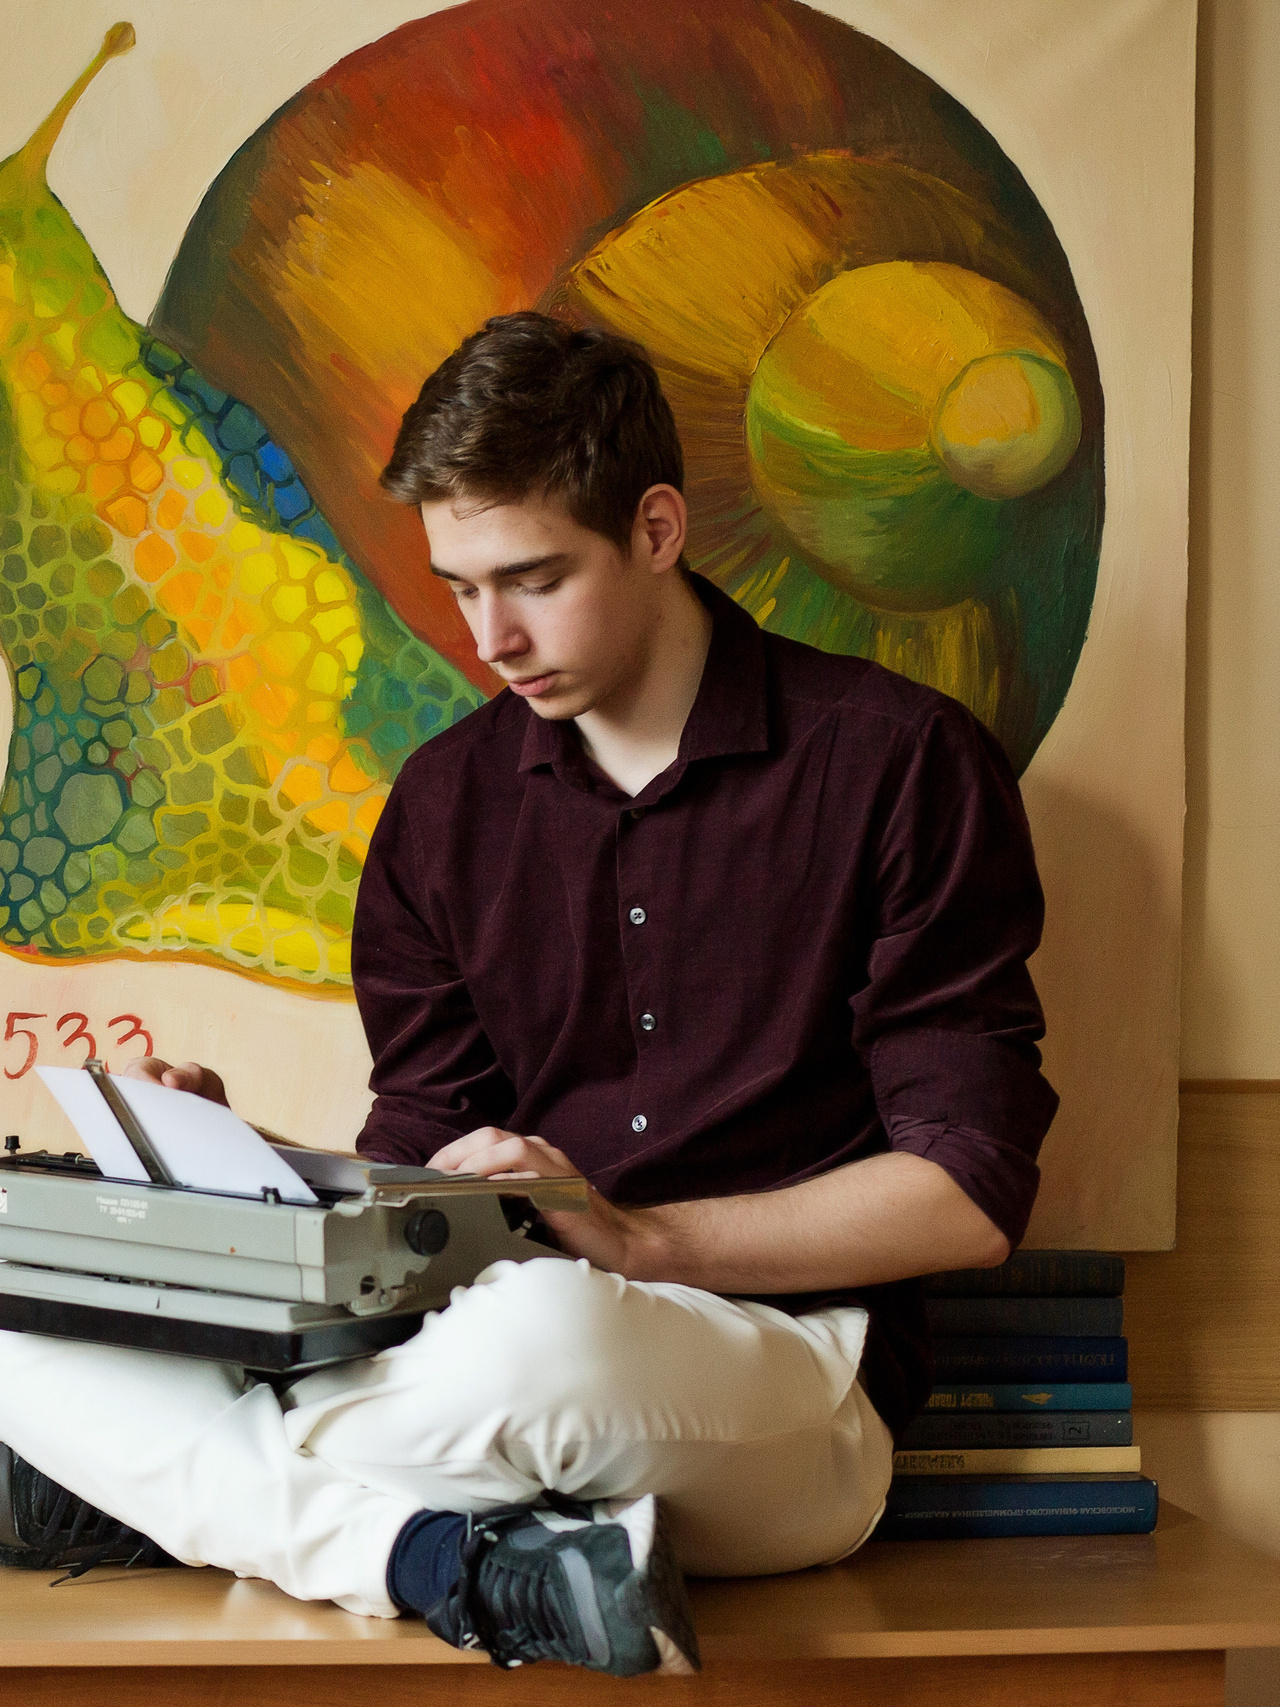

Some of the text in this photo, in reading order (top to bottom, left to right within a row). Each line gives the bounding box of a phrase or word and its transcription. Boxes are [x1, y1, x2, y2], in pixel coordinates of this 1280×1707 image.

[924, 1393, 957, 1408] ГОВАР
[904, 1509, 950, 1519] АКАДЕМИЯ
[1079, 1505, 1136, 1515] МОСКОВСКАЯ
